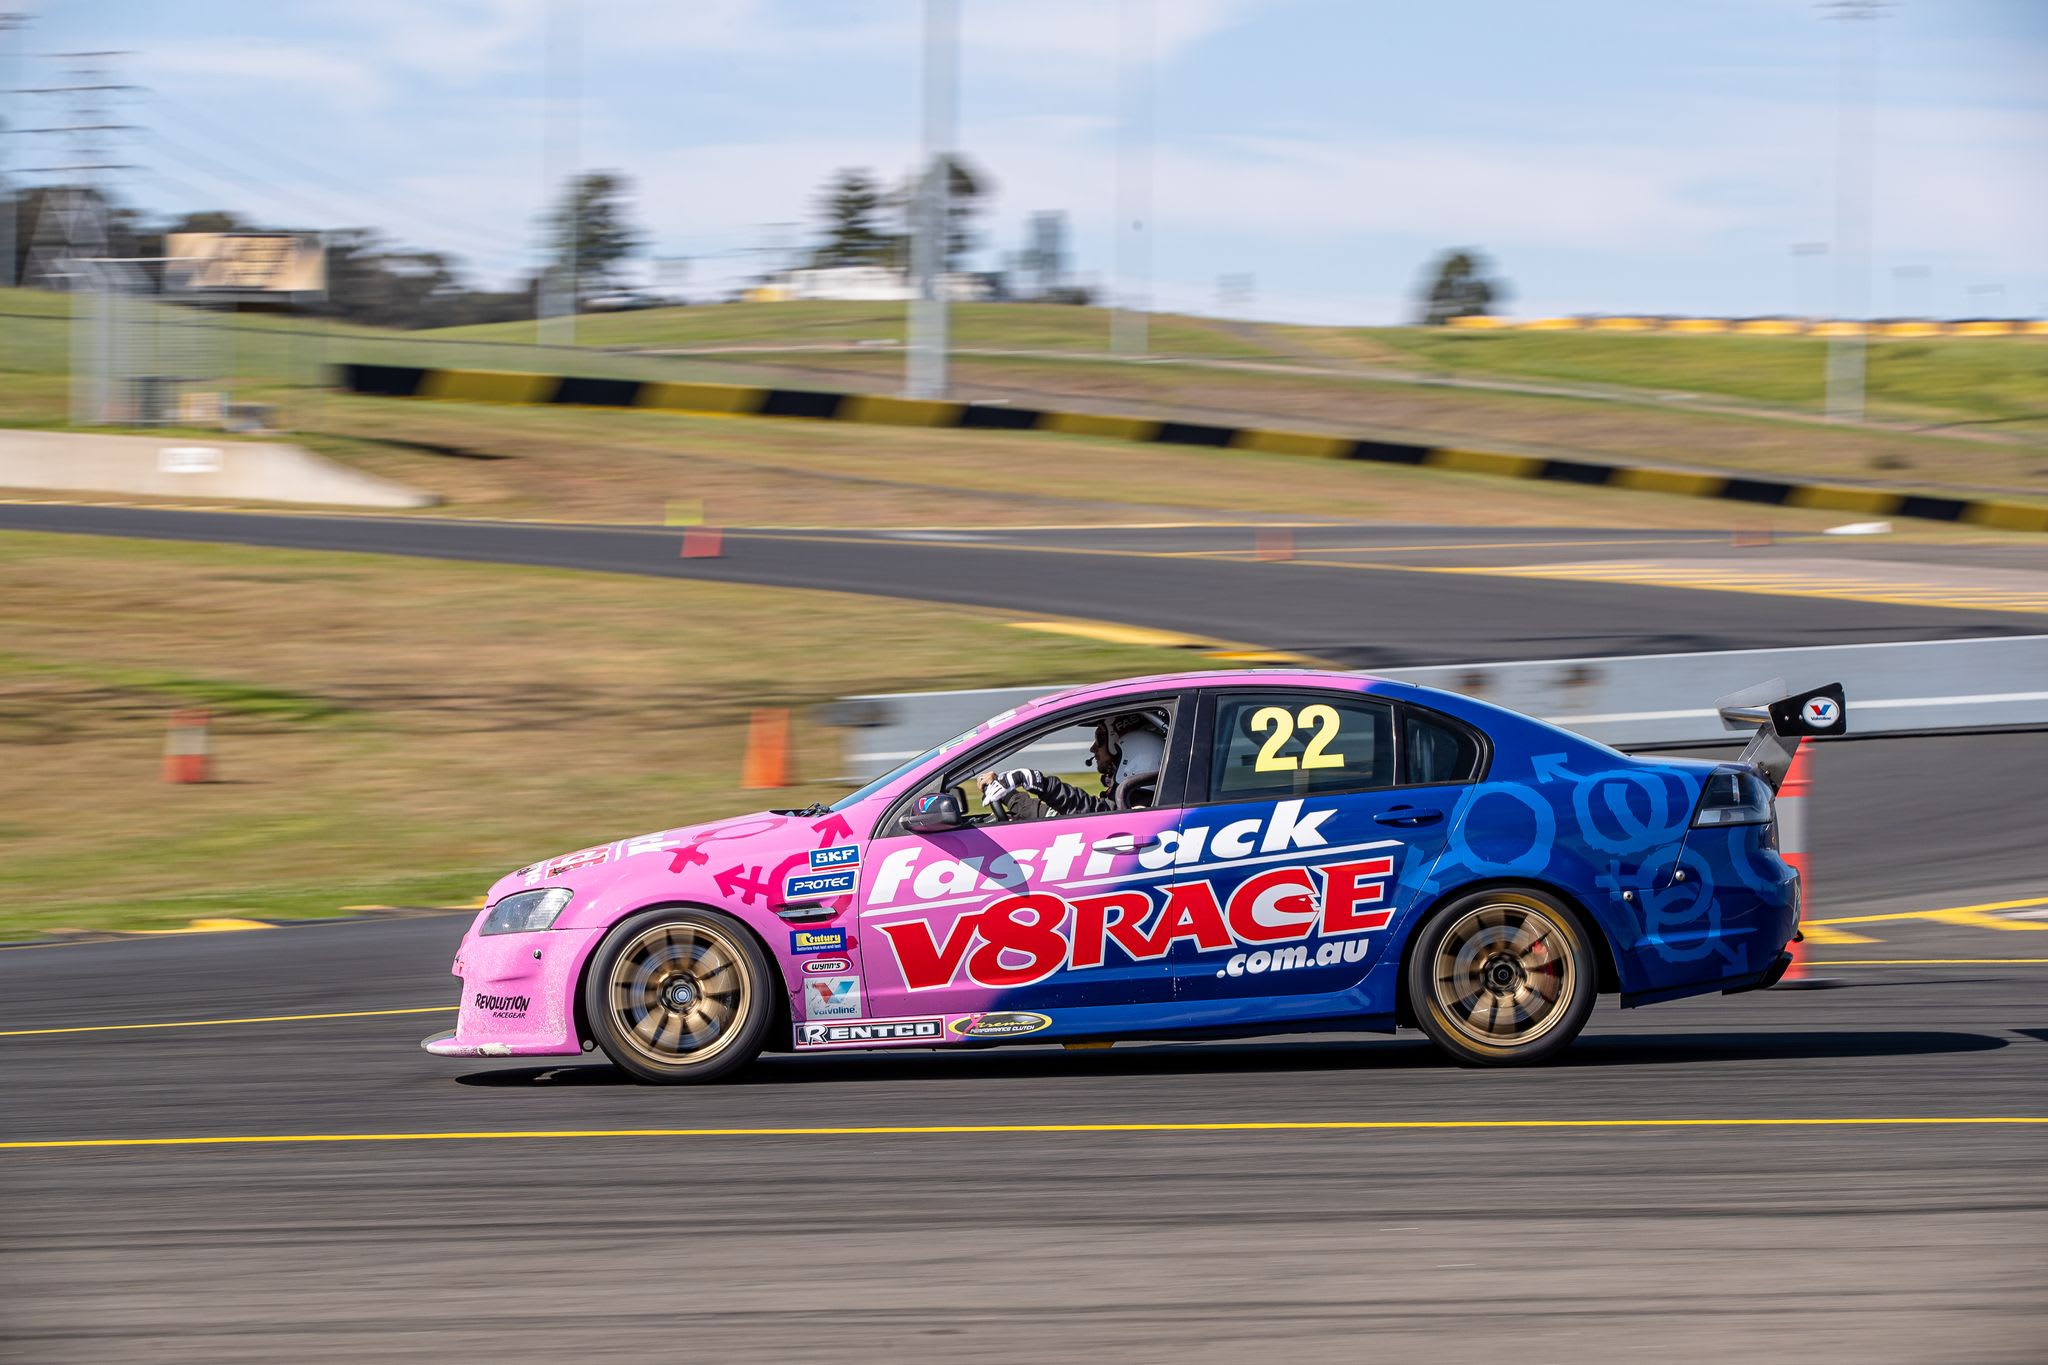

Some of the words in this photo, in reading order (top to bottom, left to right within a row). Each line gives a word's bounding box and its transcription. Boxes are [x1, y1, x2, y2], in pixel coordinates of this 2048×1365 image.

[1251, 704, 1345, 772] 22
[815, 849, 855, 864] SKF
[867, 799, 1337, 905] fastrack
[794, 876, 850, 892] PROTEC
[874, 855, 1397, 993] V8RACE
[800, 932, 841, 945] Century
[1216, 938, 1369, 979] .com.au
[475, 993, 530, 1012] REVOLUTION
[492, 1011, 526, 1019] RACEGEAR
[803, 1022, 936, 1045] RENTCO
